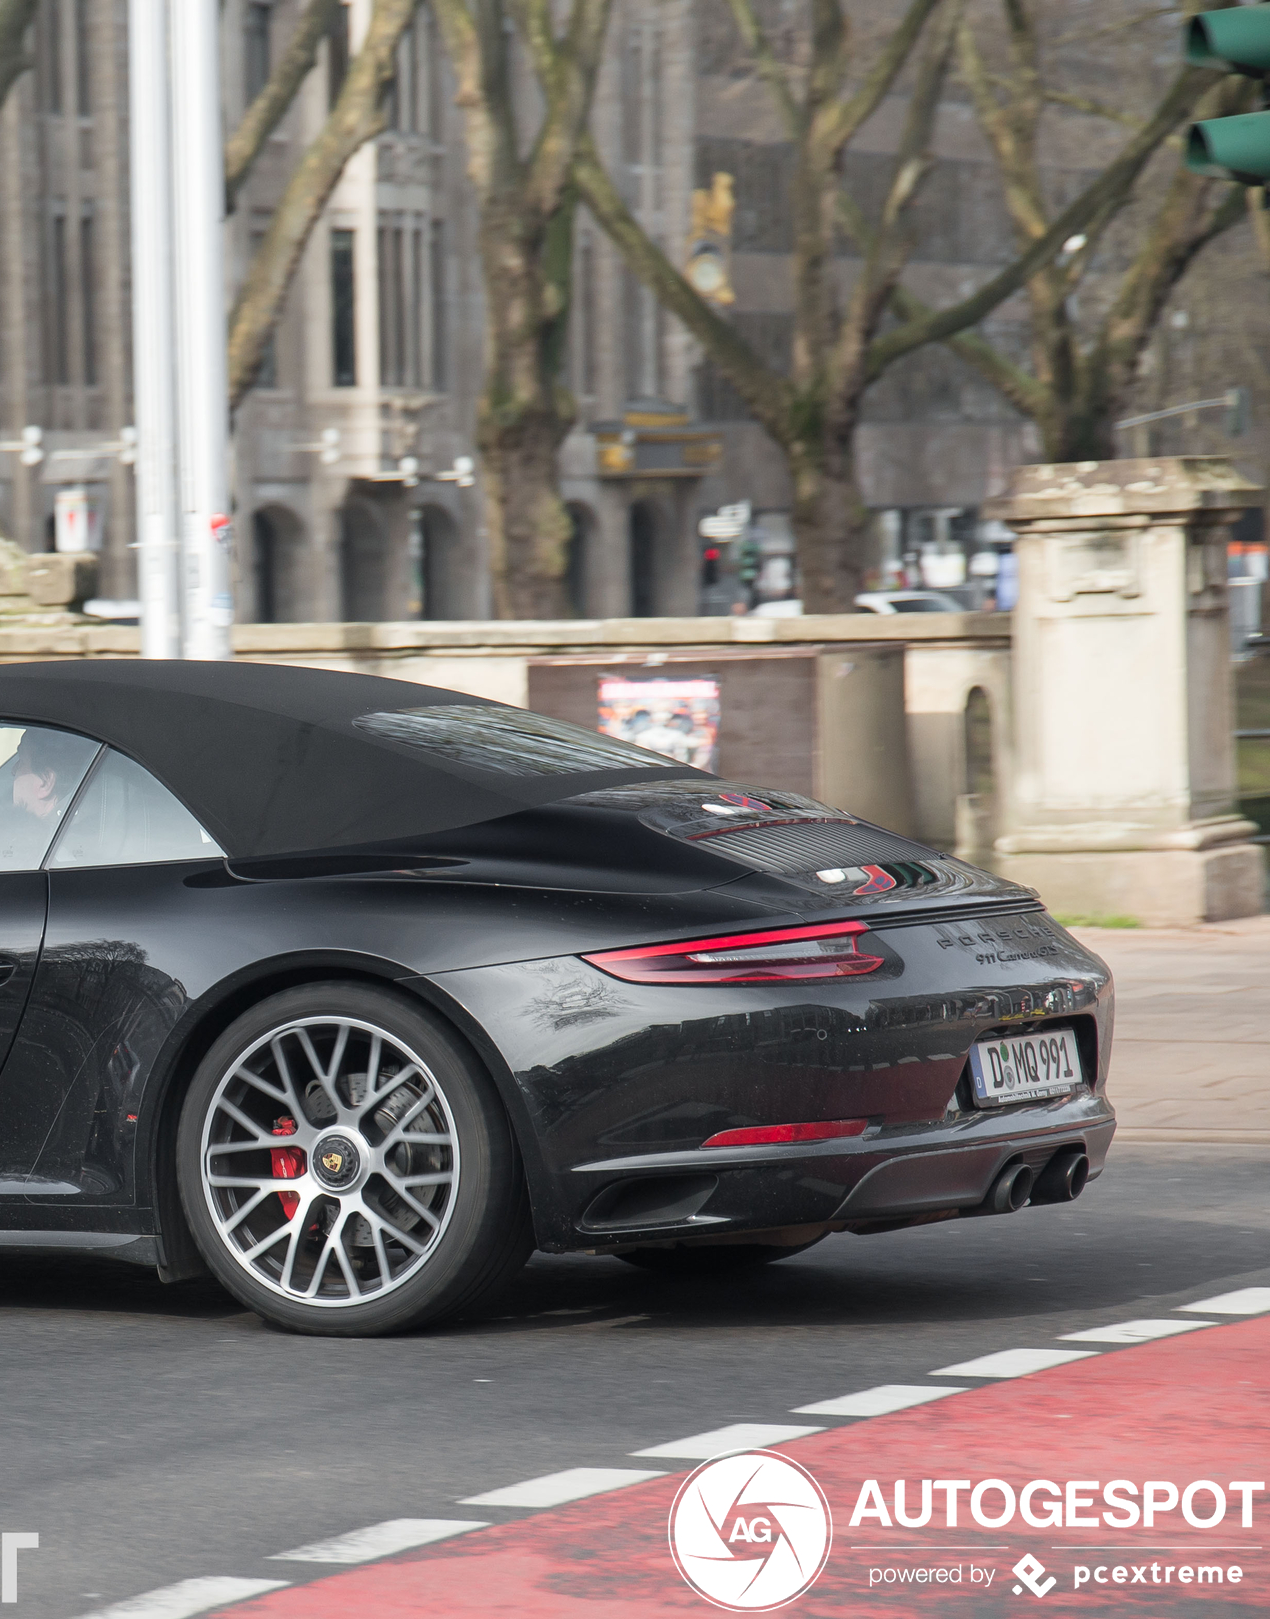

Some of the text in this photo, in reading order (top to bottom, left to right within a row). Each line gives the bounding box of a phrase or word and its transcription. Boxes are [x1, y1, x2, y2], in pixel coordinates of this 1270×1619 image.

[937, 926, 1056, 950] PORSCHE
[975, 952, 996, 965] 911
[987, 1036, 1074, 1089] D MQ 991
